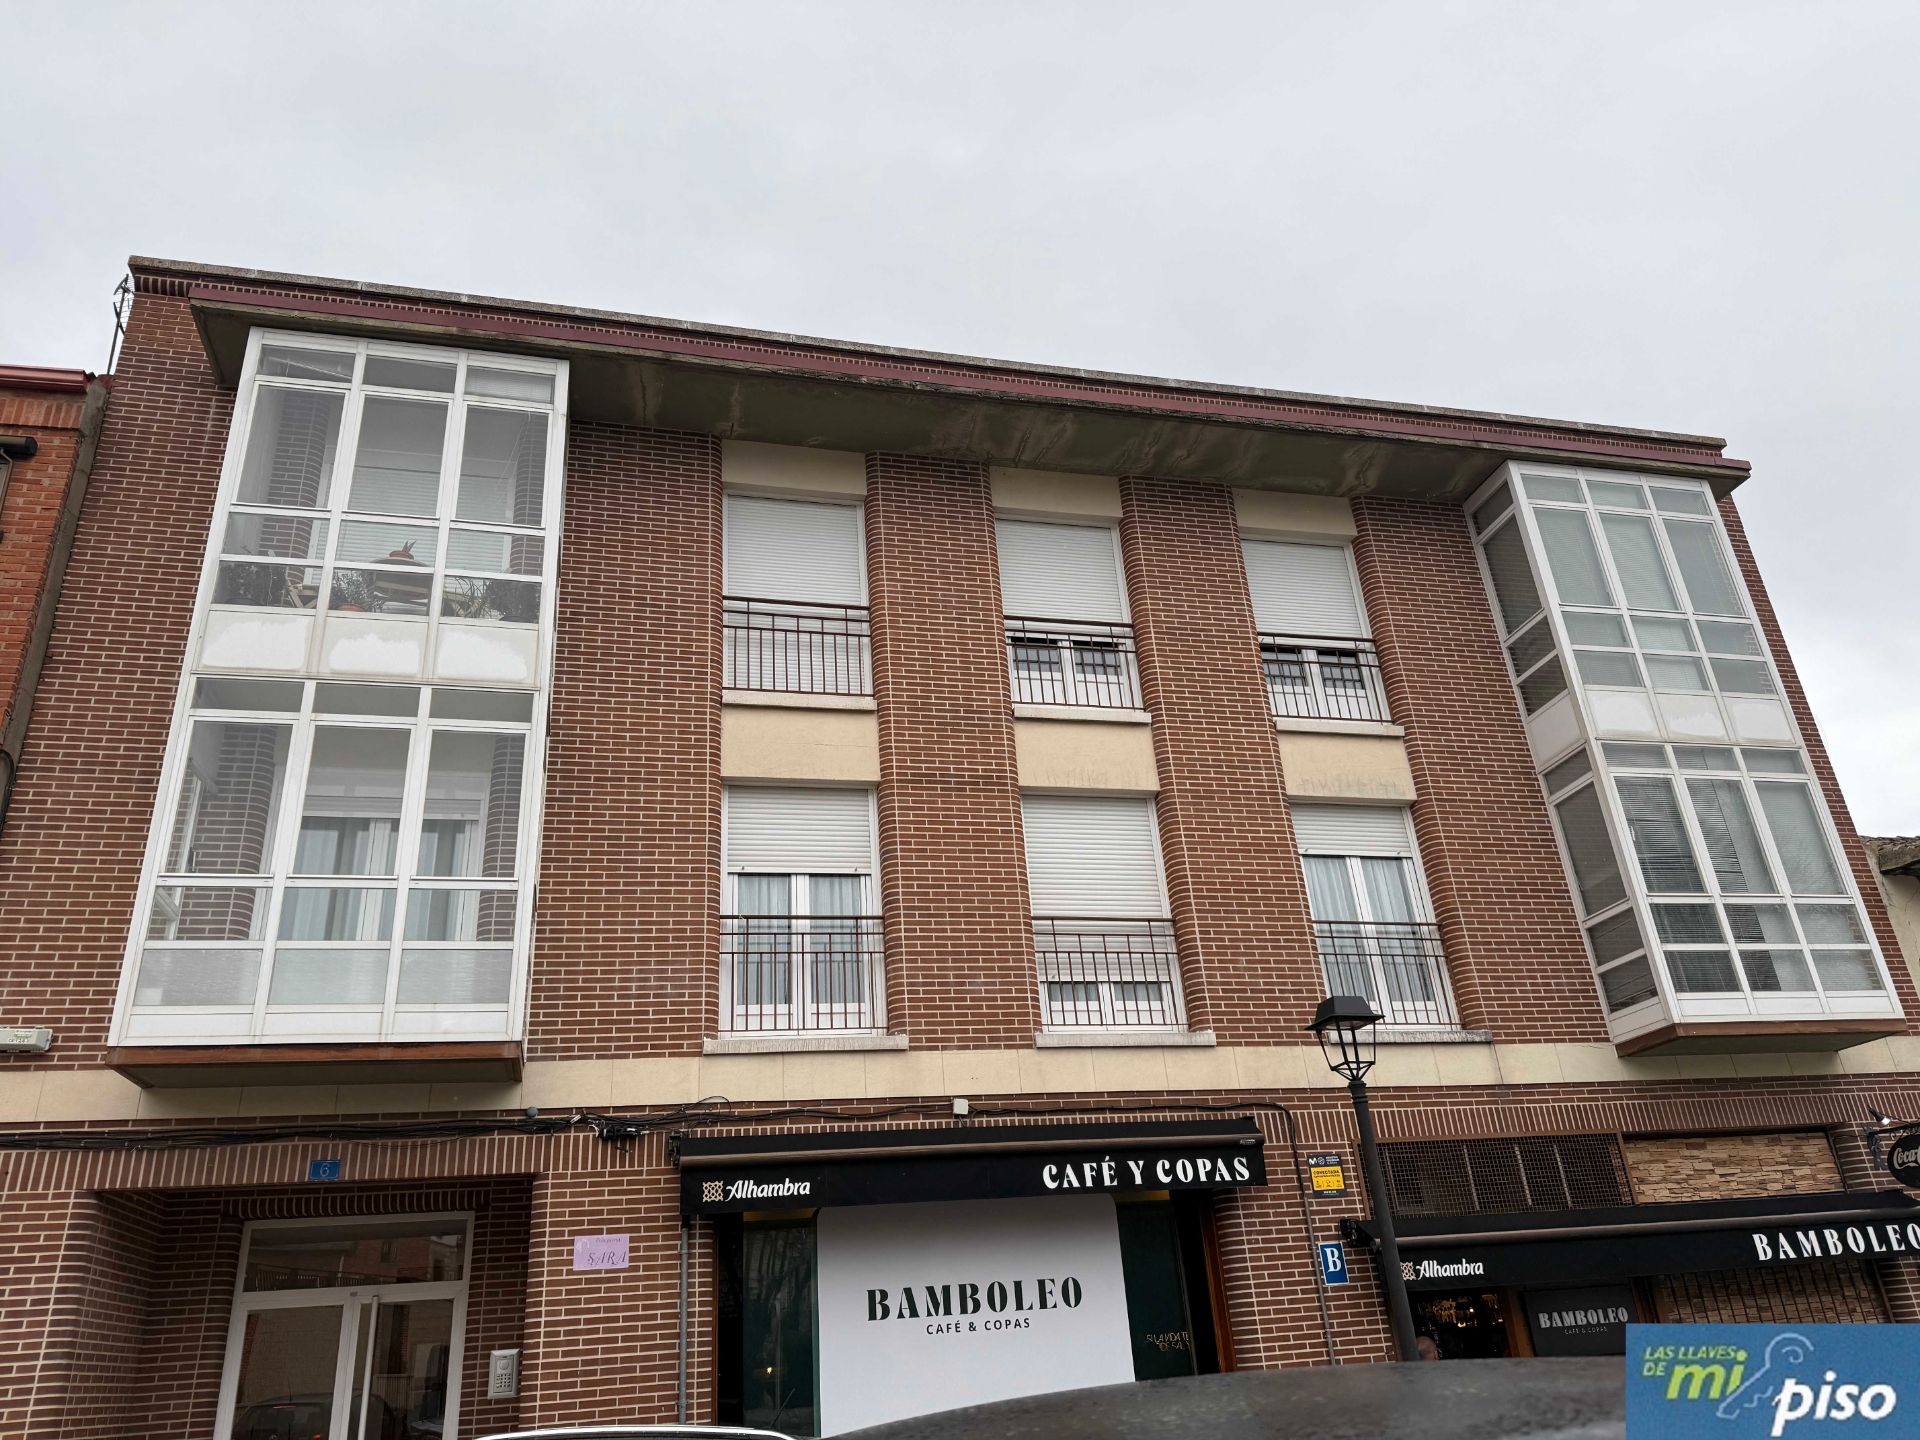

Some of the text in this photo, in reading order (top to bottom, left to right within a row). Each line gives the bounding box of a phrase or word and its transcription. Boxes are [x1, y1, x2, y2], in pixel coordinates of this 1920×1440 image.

[320, 1162, 330, 1177] 6
[1042, 1156, 1250, 1189] CAFÉ Y COPAS
[724, 1178, 811, 1202] Alhambra
[1752, 1223, 1920, 1261] BAMBOLEO
[1324, 1247, 1342, 1273] B
[1415, 1258, 1484, 1281] Alhambra
[866, 1276, 1082, 1322] BAMBOLEO
[926, 1317, 1031, 1335] CAFÉ & COPAS
[1538, 1306, 1629, 1329] BAMBOLEO
